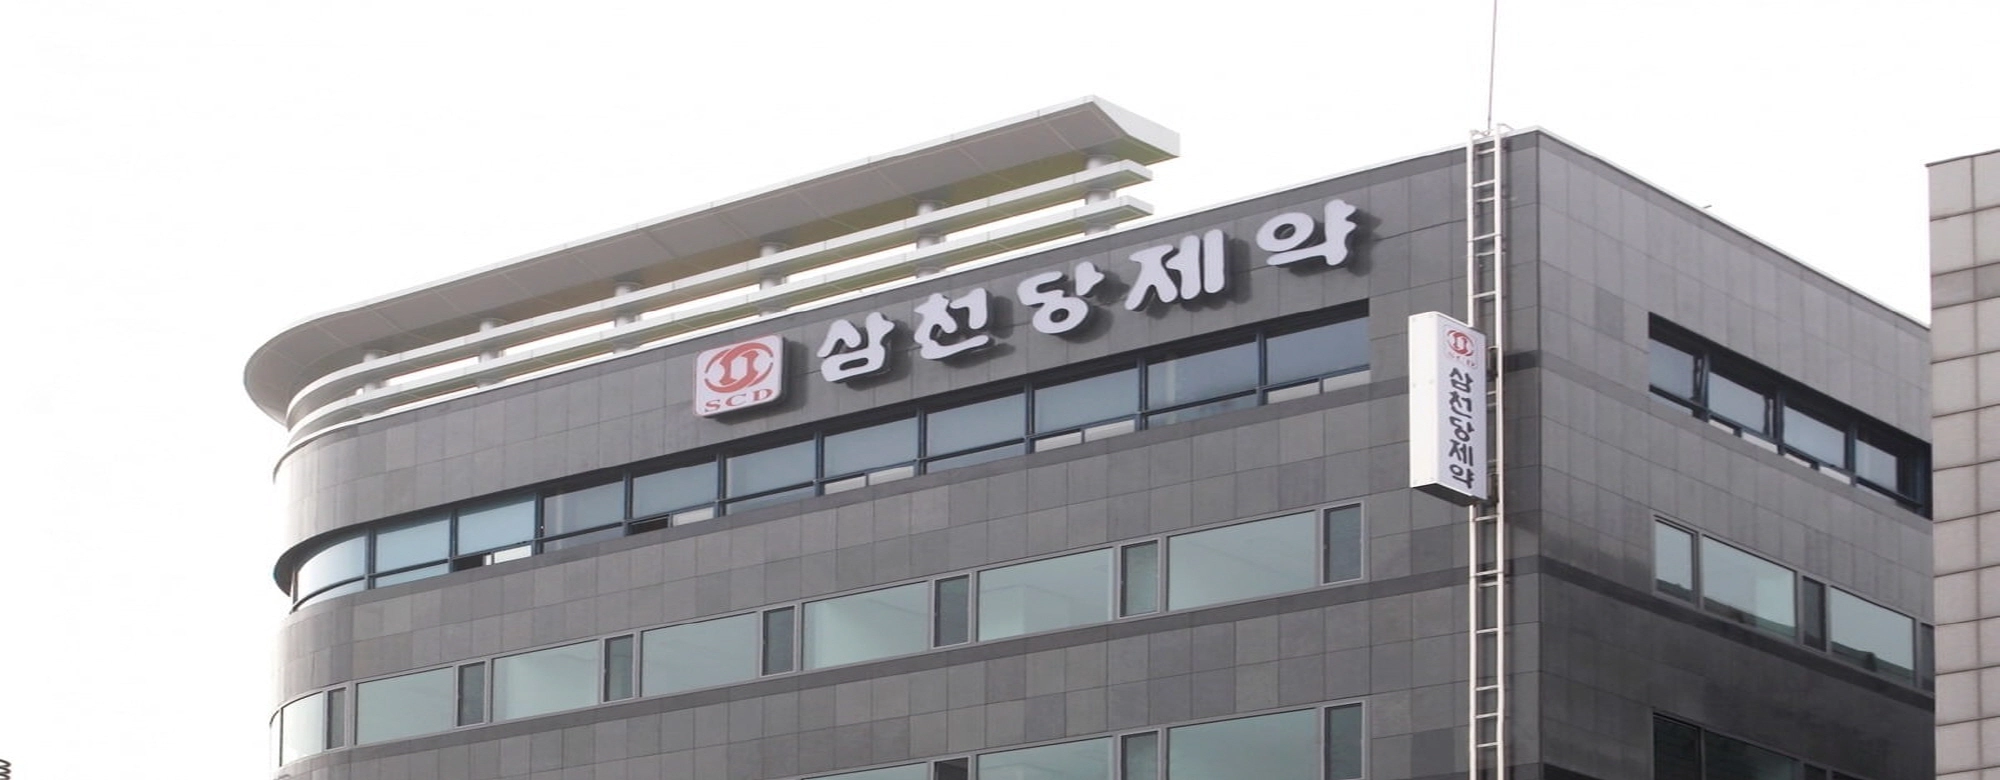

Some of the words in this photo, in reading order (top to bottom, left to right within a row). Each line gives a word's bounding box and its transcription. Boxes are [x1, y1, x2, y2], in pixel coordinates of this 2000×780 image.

[816, 199, 1357, 384] 삼천당제약
[704, 388, 773, 412] SCD
[1449, 367, 1476, 489] 삼천당제약
